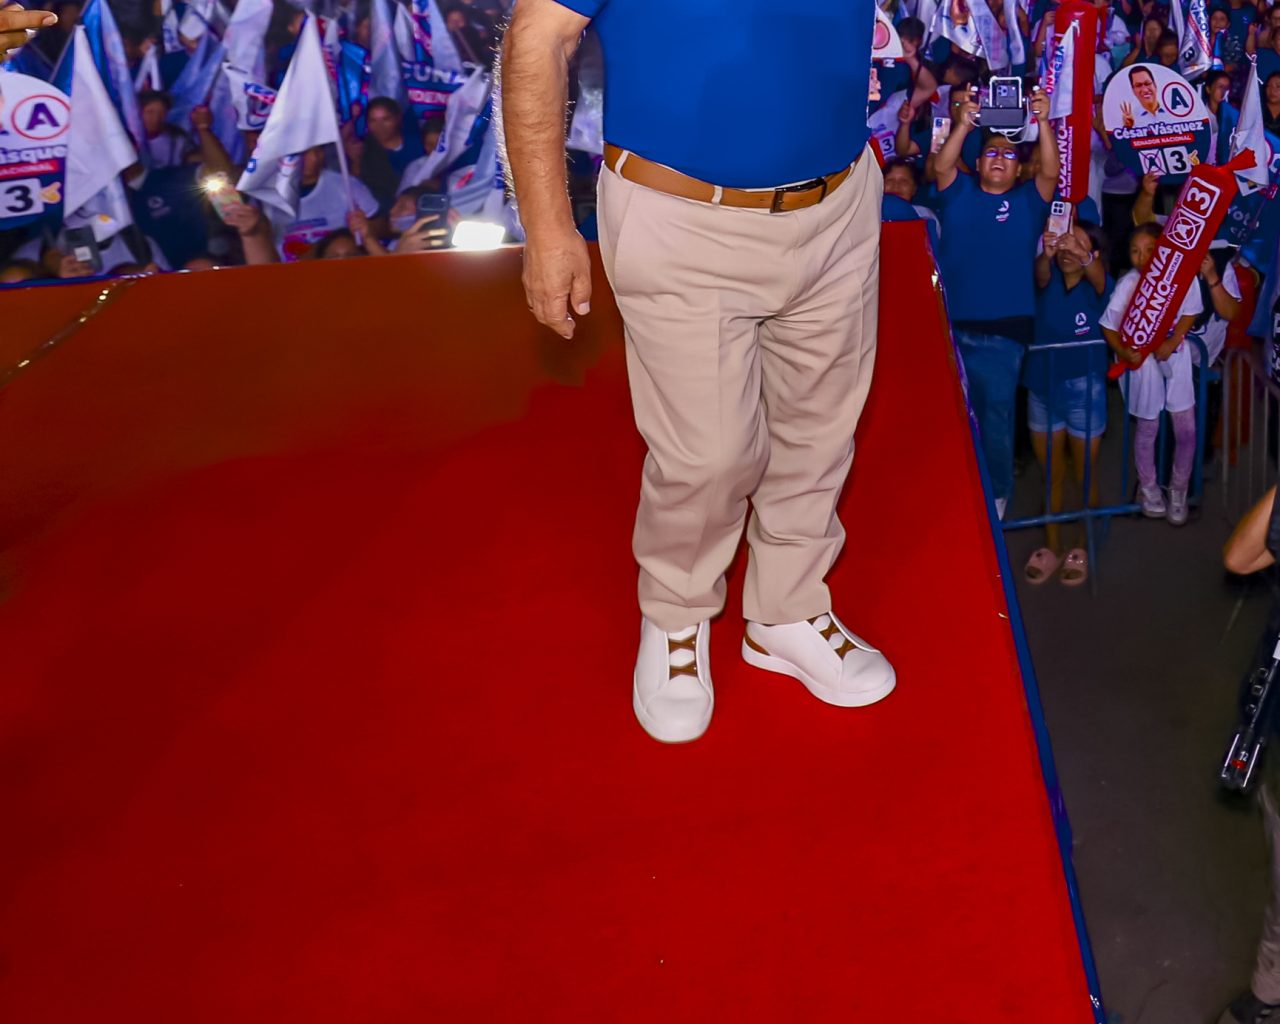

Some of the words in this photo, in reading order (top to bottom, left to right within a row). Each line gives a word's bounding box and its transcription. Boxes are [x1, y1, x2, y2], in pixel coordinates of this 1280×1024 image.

[1114, 126, 1149, 140] César
[1149, 120, 1204, 136] Vásquez
[1133, 136, 1161, 147] SENADOR
[1161, 134, 1192, 144] NACIONAL
[1170, 149, 1187, 171] 3
[5, 185, 33, 213] 3
[1186, 185, 1211, 211] 3
